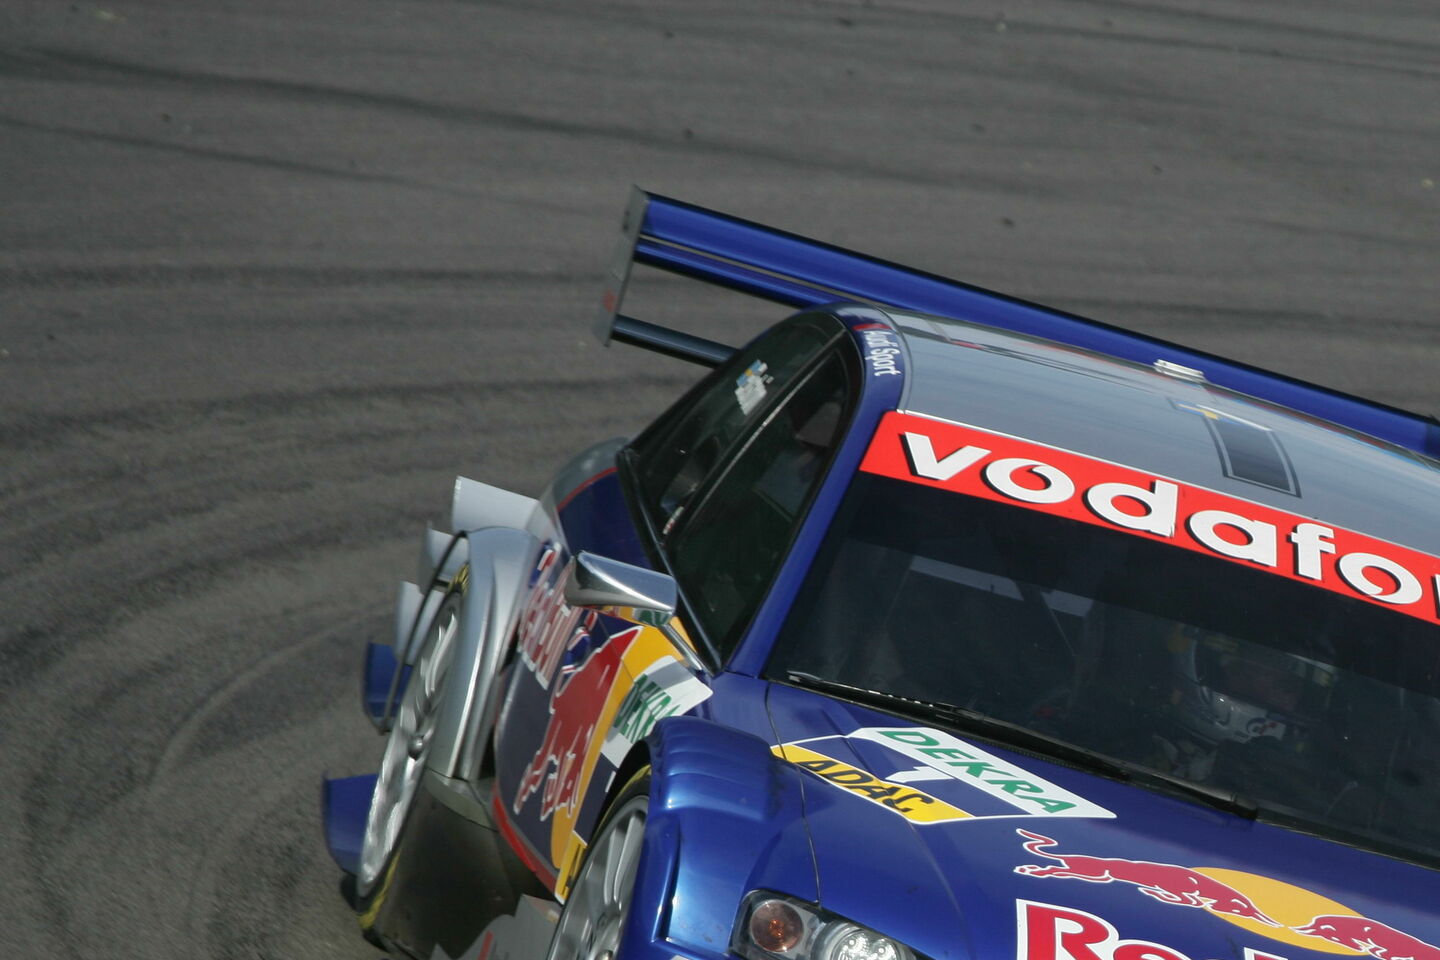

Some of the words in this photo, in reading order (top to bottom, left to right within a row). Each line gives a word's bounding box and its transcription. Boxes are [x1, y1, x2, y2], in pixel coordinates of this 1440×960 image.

[864, 348, 902, 377] Sport
[804, 758, 936, 814] ADAC
[876, 730, 1078, 814] DEKRA
